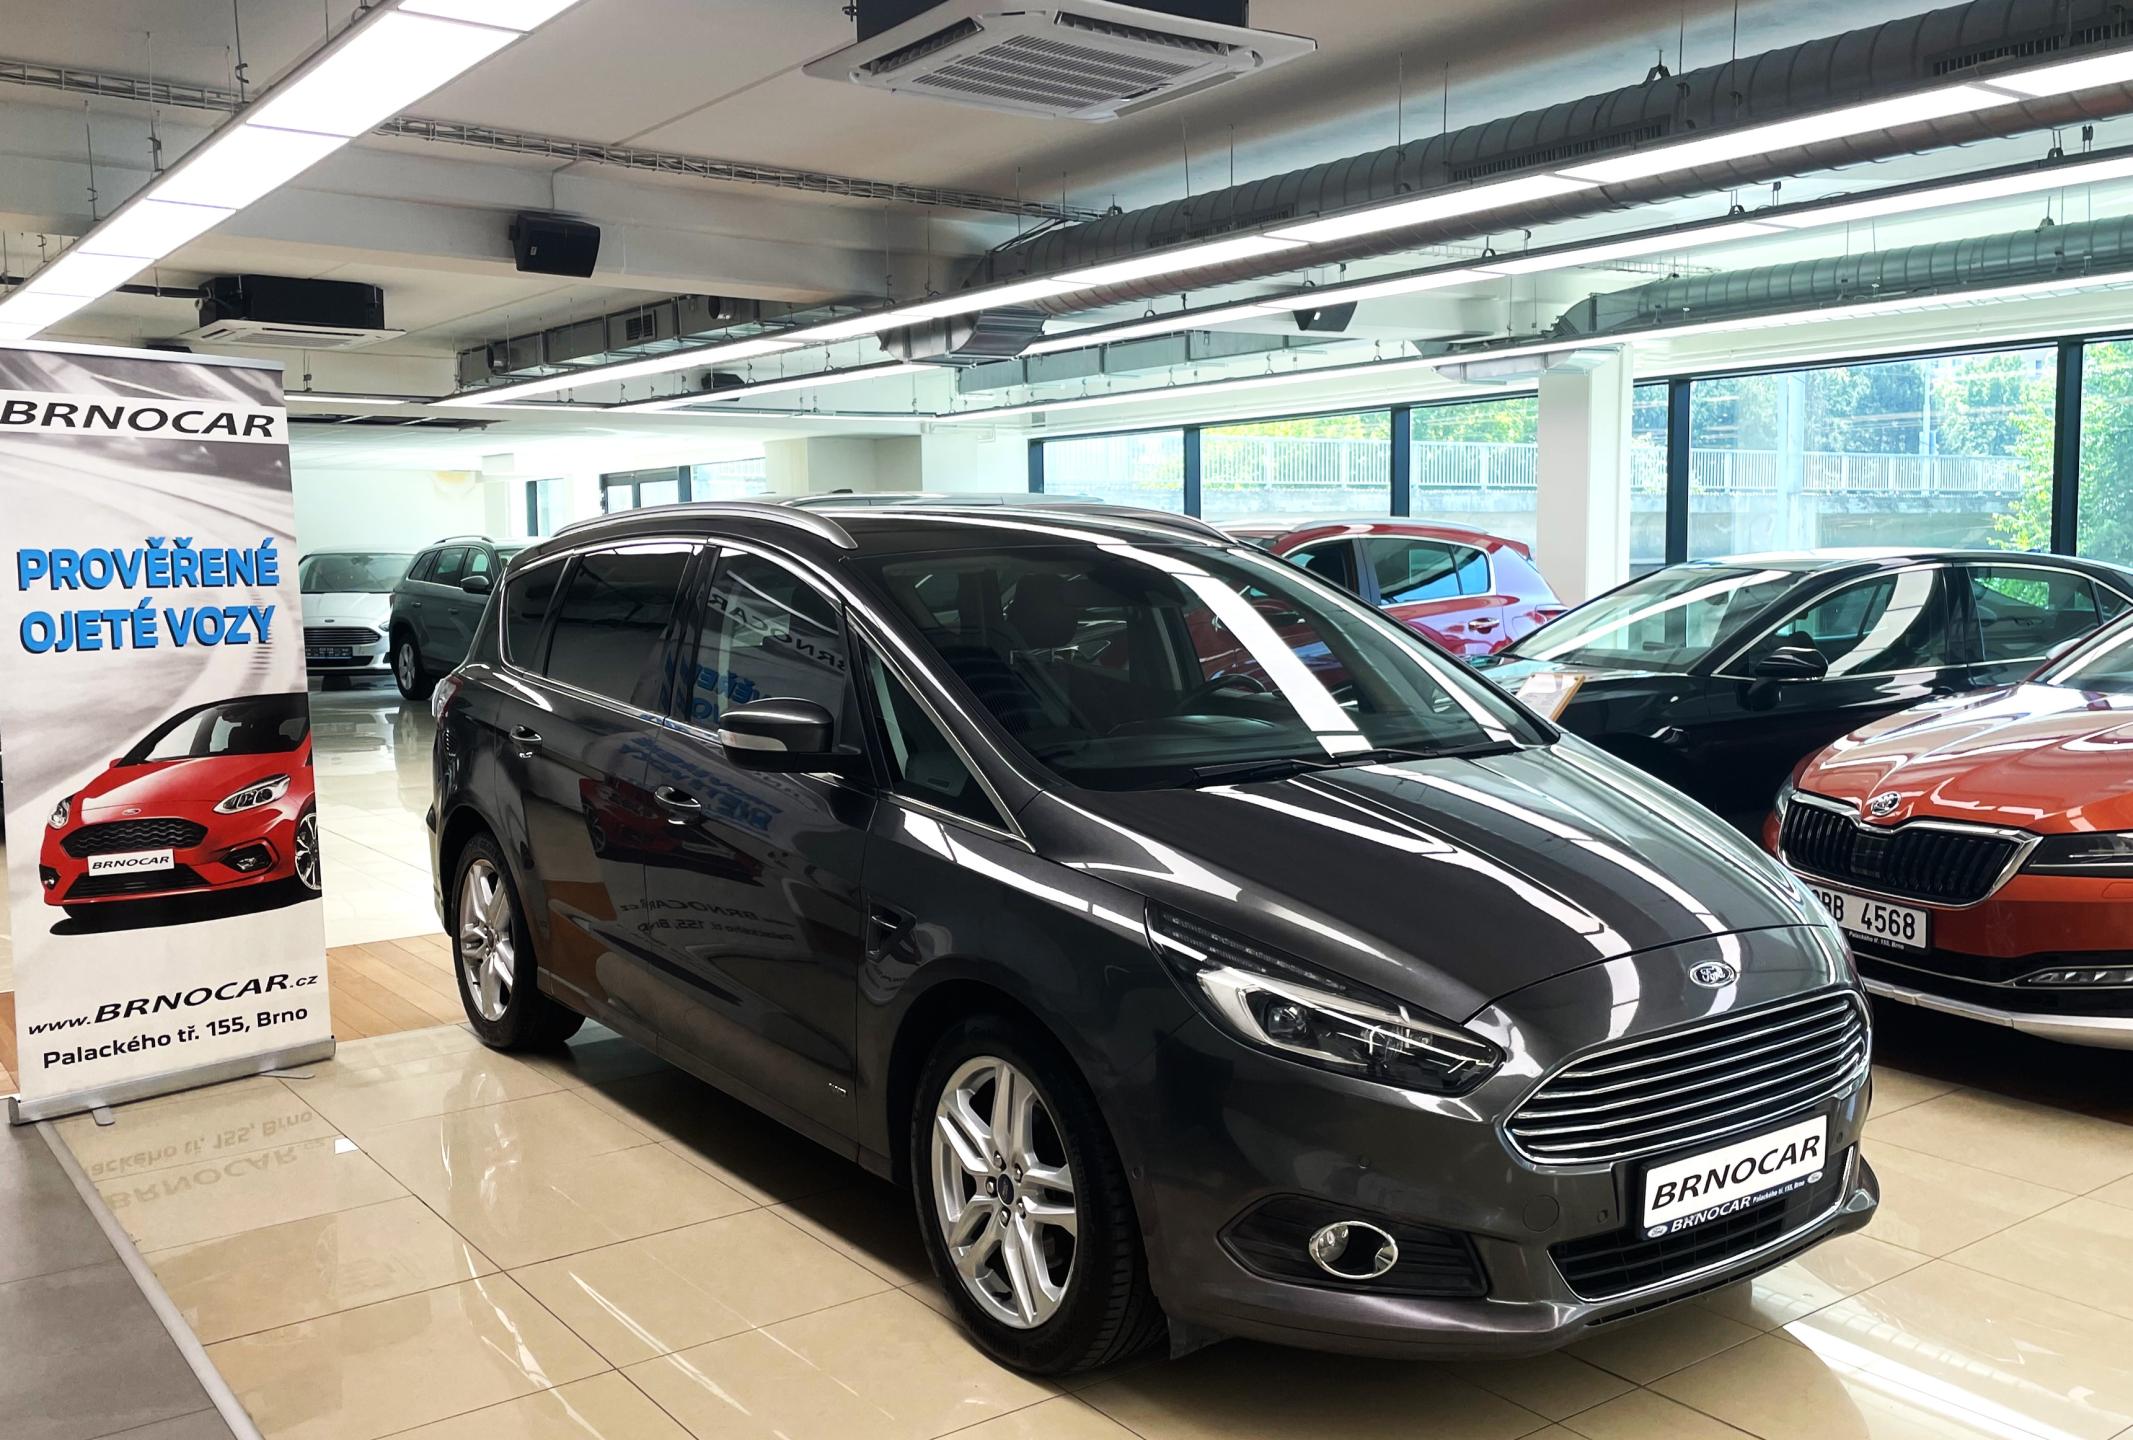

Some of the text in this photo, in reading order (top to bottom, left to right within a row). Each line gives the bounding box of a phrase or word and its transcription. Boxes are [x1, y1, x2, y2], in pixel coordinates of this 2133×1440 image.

[0, 400, 274, 437] BRNOCAR
[17, 536, 280, 590] PROVĚŘENÉ
[19, 596, 276, 654] OJETÉ VOZY
[92, 853, 169, 871] BRNOCAR
[1811, 889, 1915, 940] BB 4568
[28, 973, 318, 1035] www.BRNOCAR.cz
[43, 1008, 308, 1069] Palackého tř. 155, Brno
[1651, 1135, 1820, 1211] BRNOCAR
[1671, 1196, 1751, 1233] BRNOCAR
